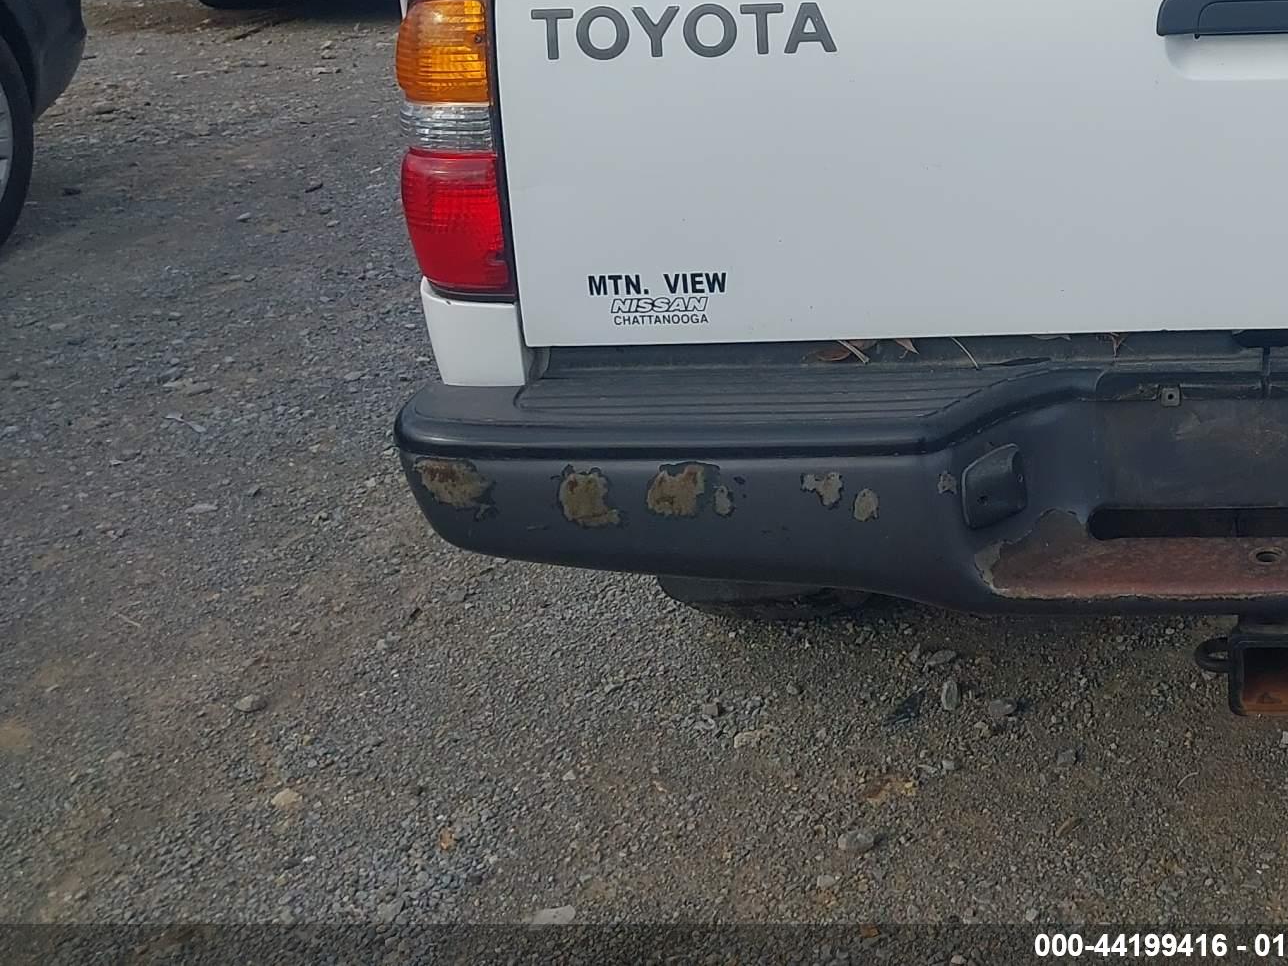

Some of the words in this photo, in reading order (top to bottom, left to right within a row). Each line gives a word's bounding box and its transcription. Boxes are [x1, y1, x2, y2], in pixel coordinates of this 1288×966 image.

[531, 2, 837, 60] TOYOTA
[588, 274, 649, 296] MTN.
[663, 272, 726, 294] VIEW
[611, 296, 708, 313] NISSAN
[613, 313, 709, 326] CHATTANOOGA
